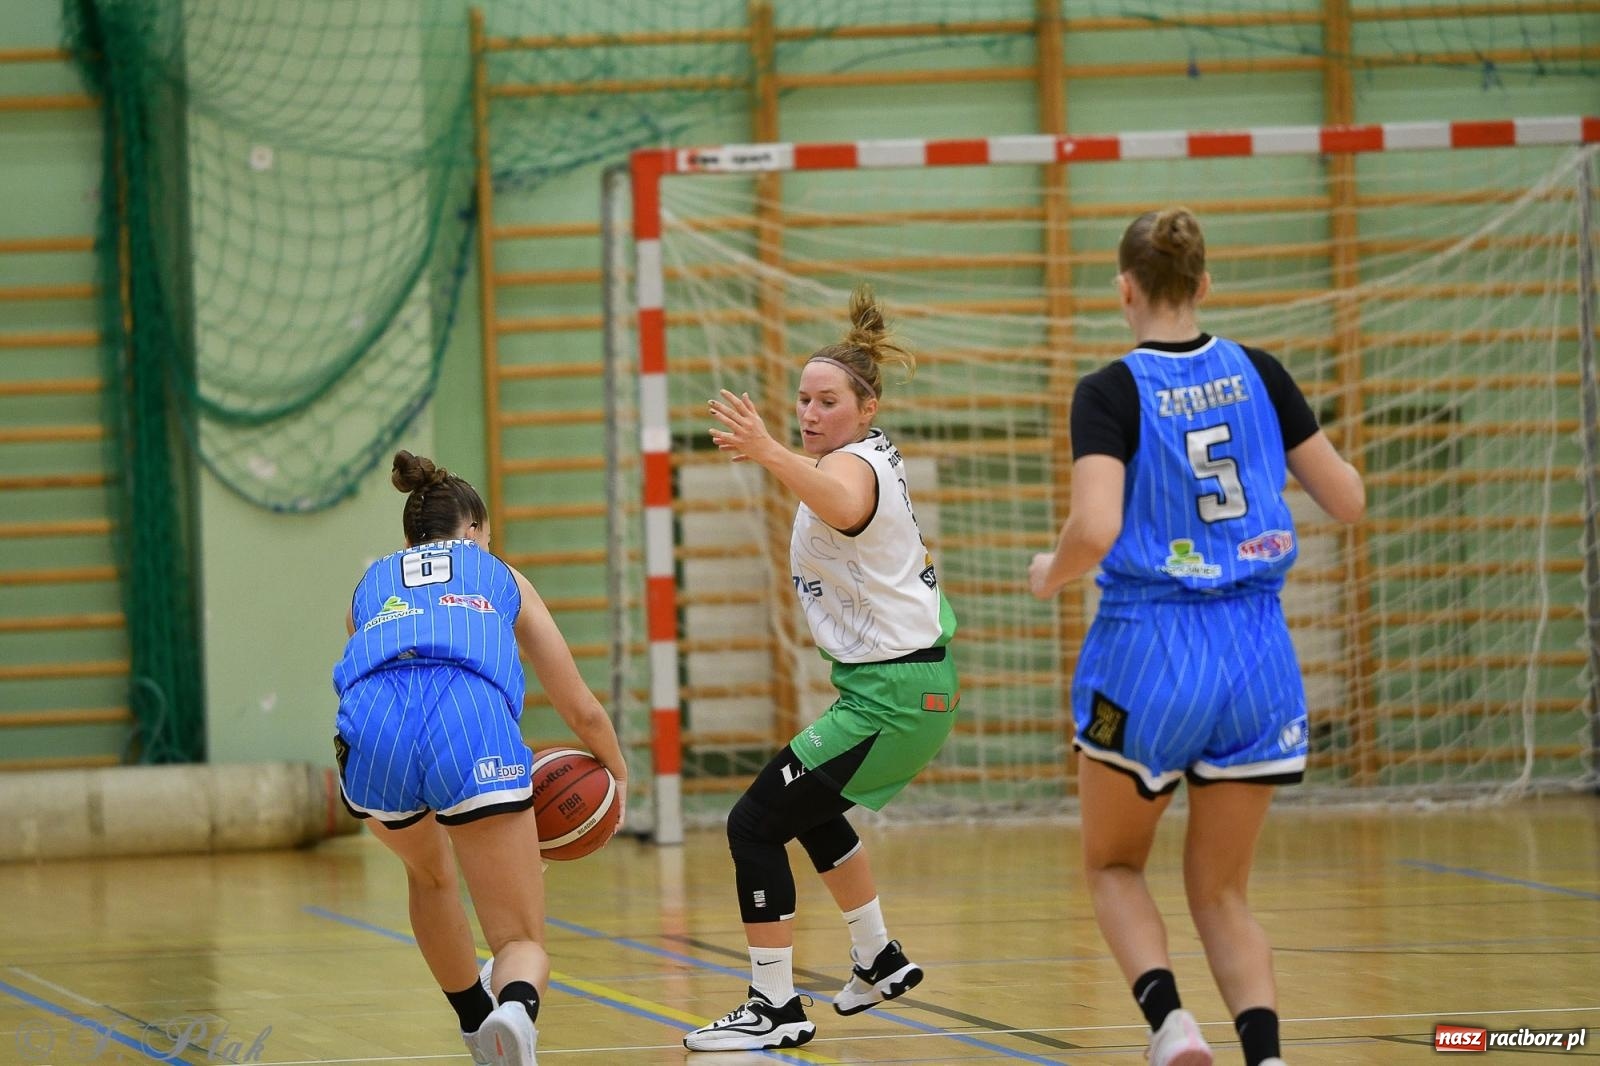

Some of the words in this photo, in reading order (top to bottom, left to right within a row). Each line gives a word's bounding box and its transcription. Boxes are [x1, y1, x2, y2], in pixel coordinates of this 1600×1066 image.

[1155, 374, 1250, 421] ZIĘBICE
[1185, 422, 1248, 525] 5
[401, 550, 453, 588] 6
[478, 760, 526, 779] MEDUS
[533, 763, 574, 800] molten
[558, 792, 583, 816] FIBA
